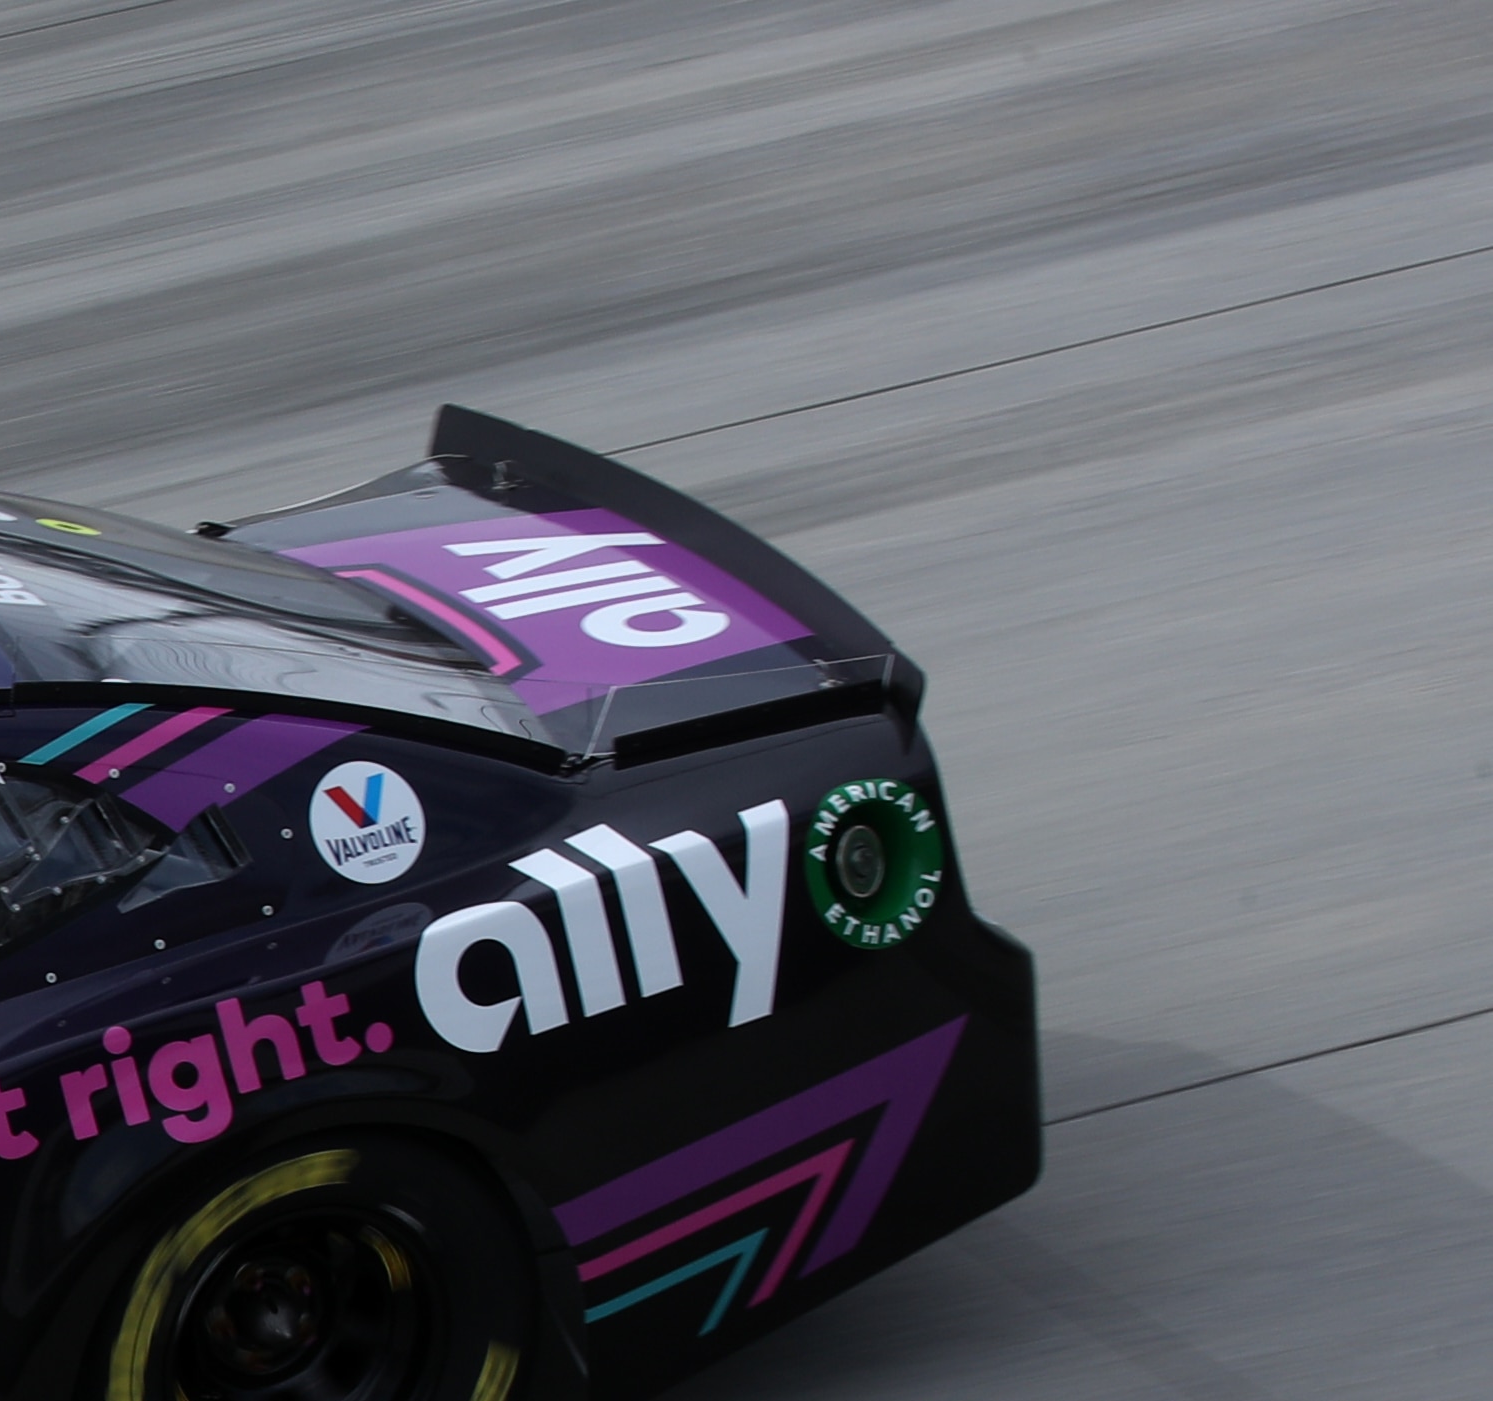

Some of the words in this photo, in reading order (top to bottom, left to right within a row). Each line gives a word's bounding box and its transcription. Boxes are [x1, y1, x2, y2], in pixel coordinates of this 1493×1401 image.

[444, 532, 732, 648] ally
[324, 815, 418, 867] VALVOLINE
[808, 781, 936, 862] AMERICAN
[415, 799, 790, 1053] ally
[824, 870, 942, 944] ETHANOL
[60, 980, 395, 1143] right.
